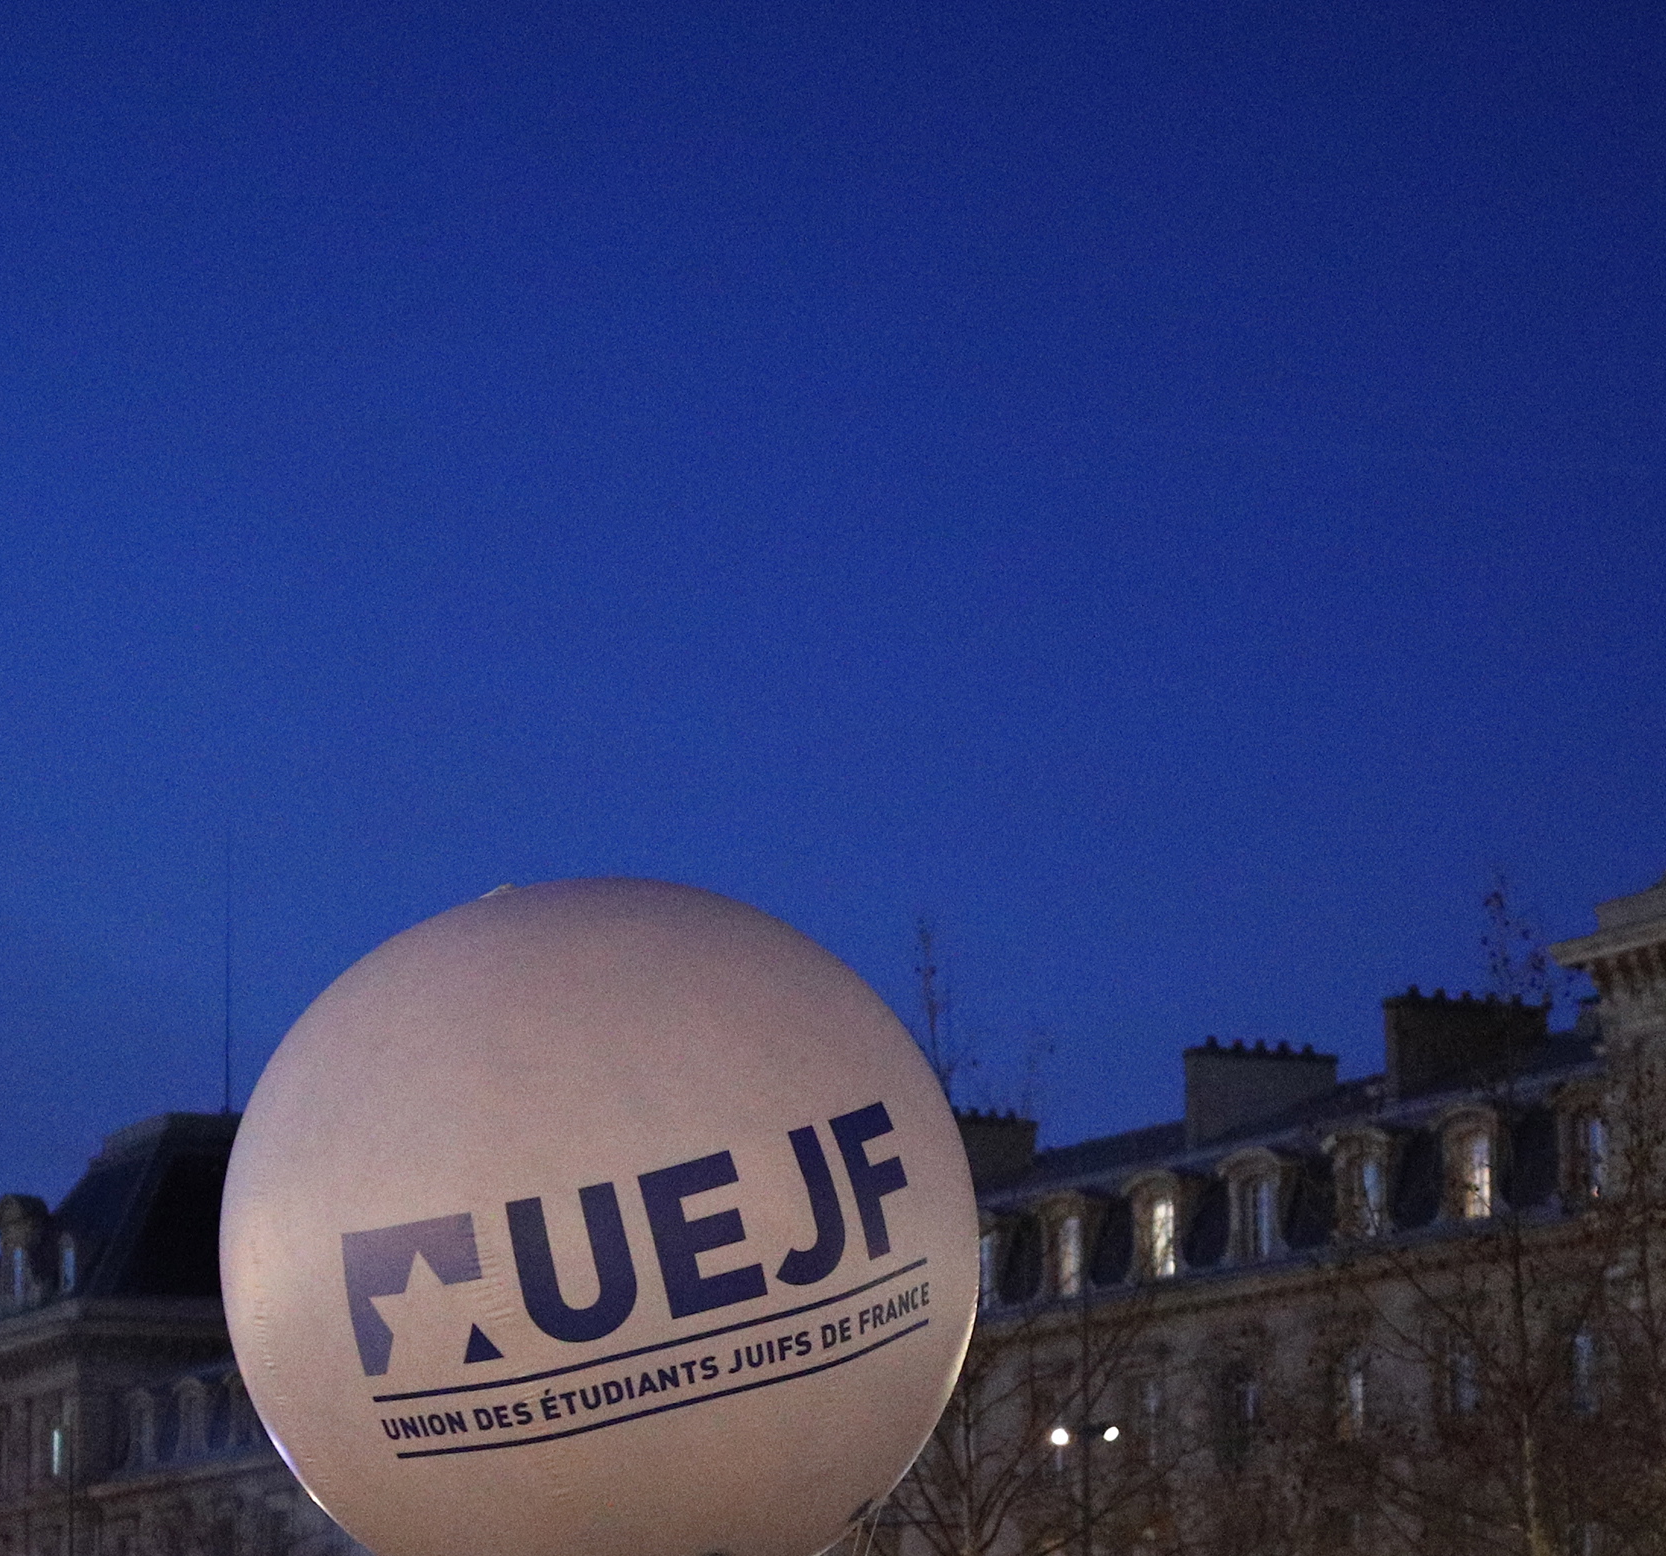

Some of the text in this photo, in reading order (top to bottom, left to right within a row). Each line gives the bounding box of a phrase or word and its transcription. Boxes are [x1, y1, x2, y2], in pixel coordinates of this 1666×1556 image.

[505, 1101, 908, 1343] UEJF
[382, 1281, 932, 1441] UNION DES ÉTUDIANTS JUIFS DE FRANCE
